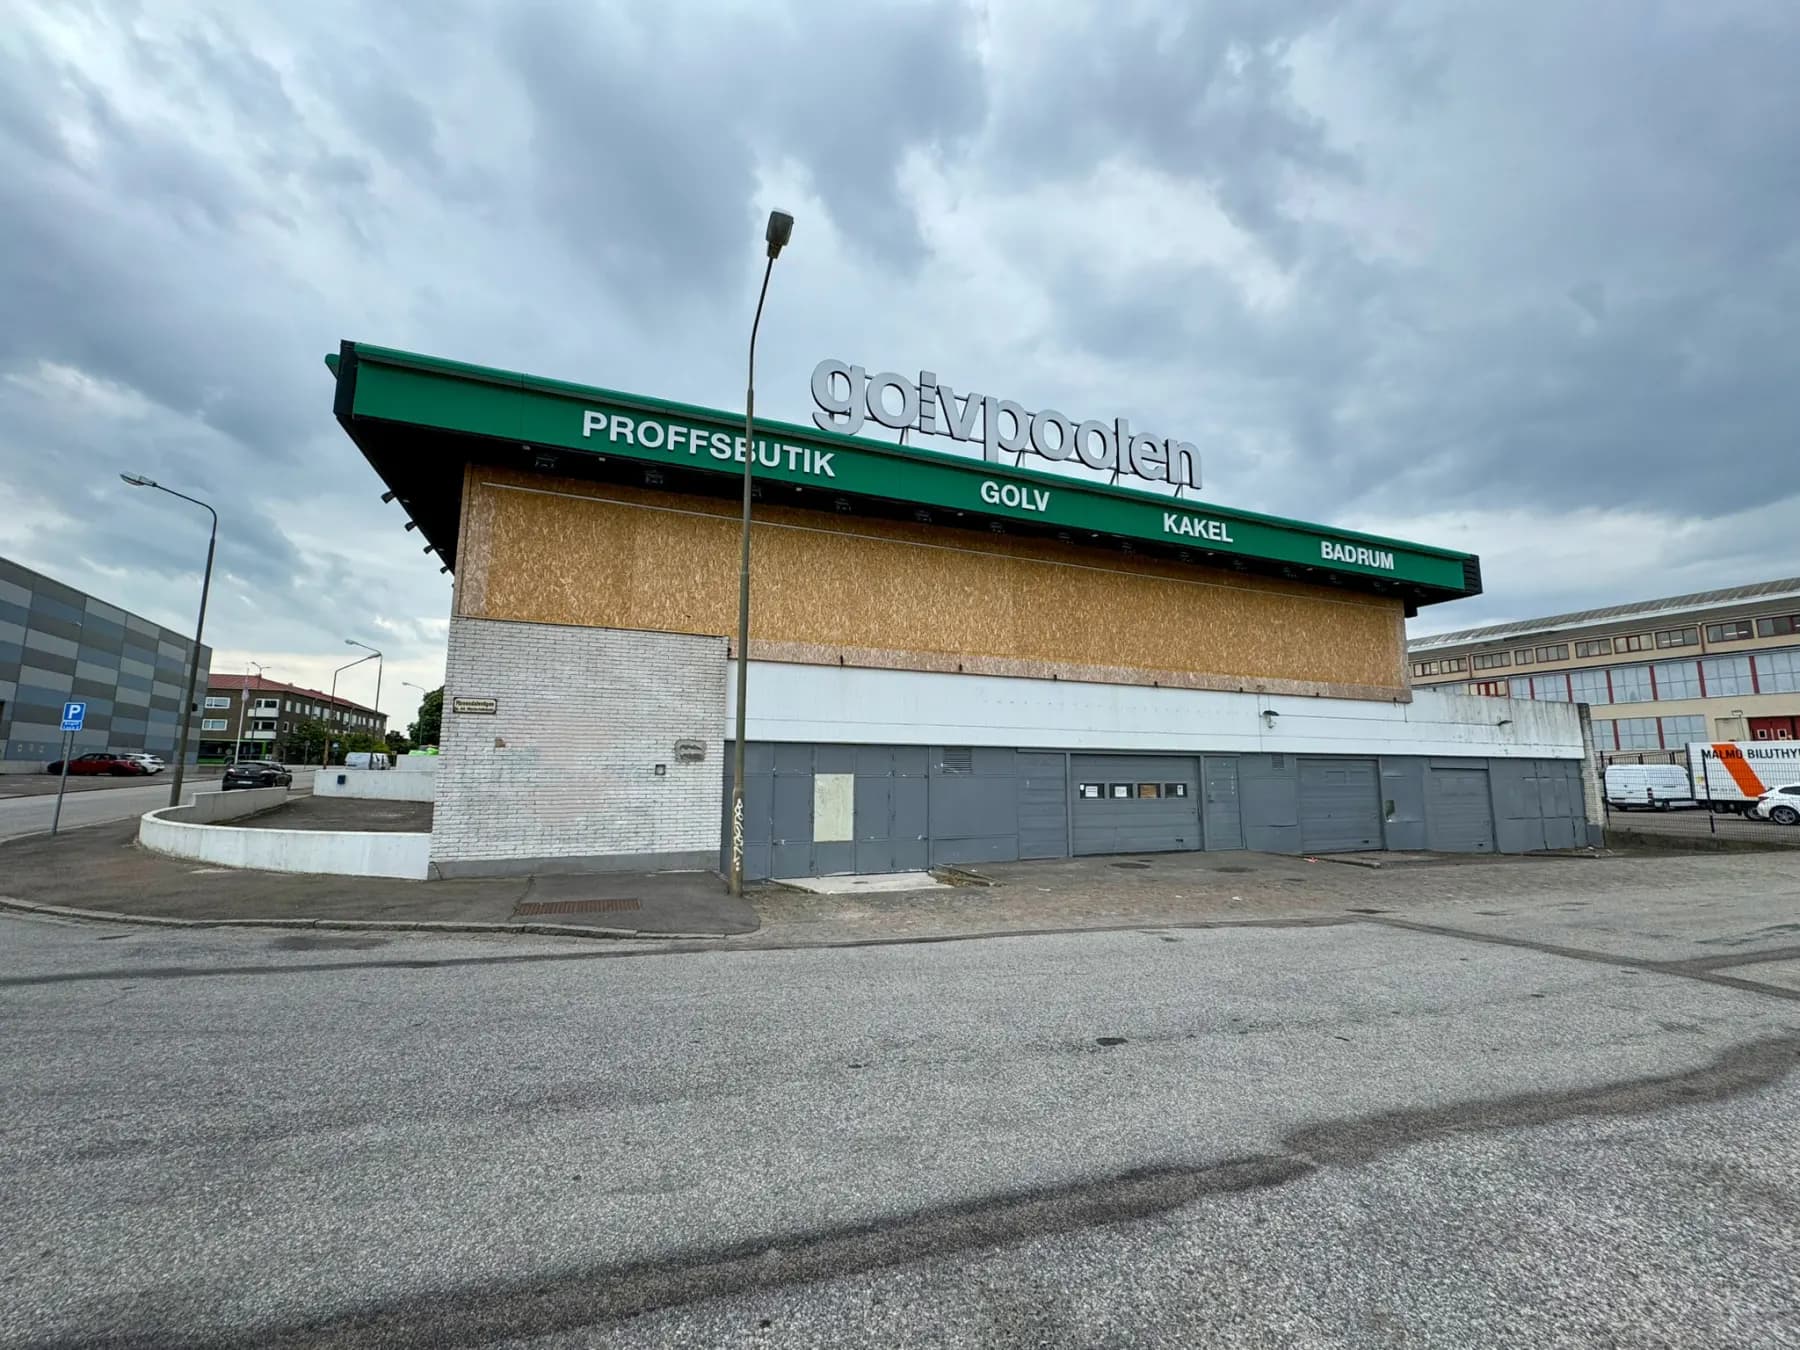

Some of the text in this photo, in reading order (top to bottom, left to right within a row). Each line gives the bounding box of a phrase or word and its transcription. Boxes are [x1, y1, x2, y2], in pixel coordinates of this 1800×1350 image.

[811, 358, 1201, 488] golvpoolen
[582, 409, 836, 477] PROFFSBUTIK
[980, 480, 1050, 513] GOLV
[1163, 511, 1234, 544] KAKEL
[1320, 540, 1395, 571] BADRUM
[68, 704, 81, 719] P
[1747, 748, 1800, 759] BILUTHY
